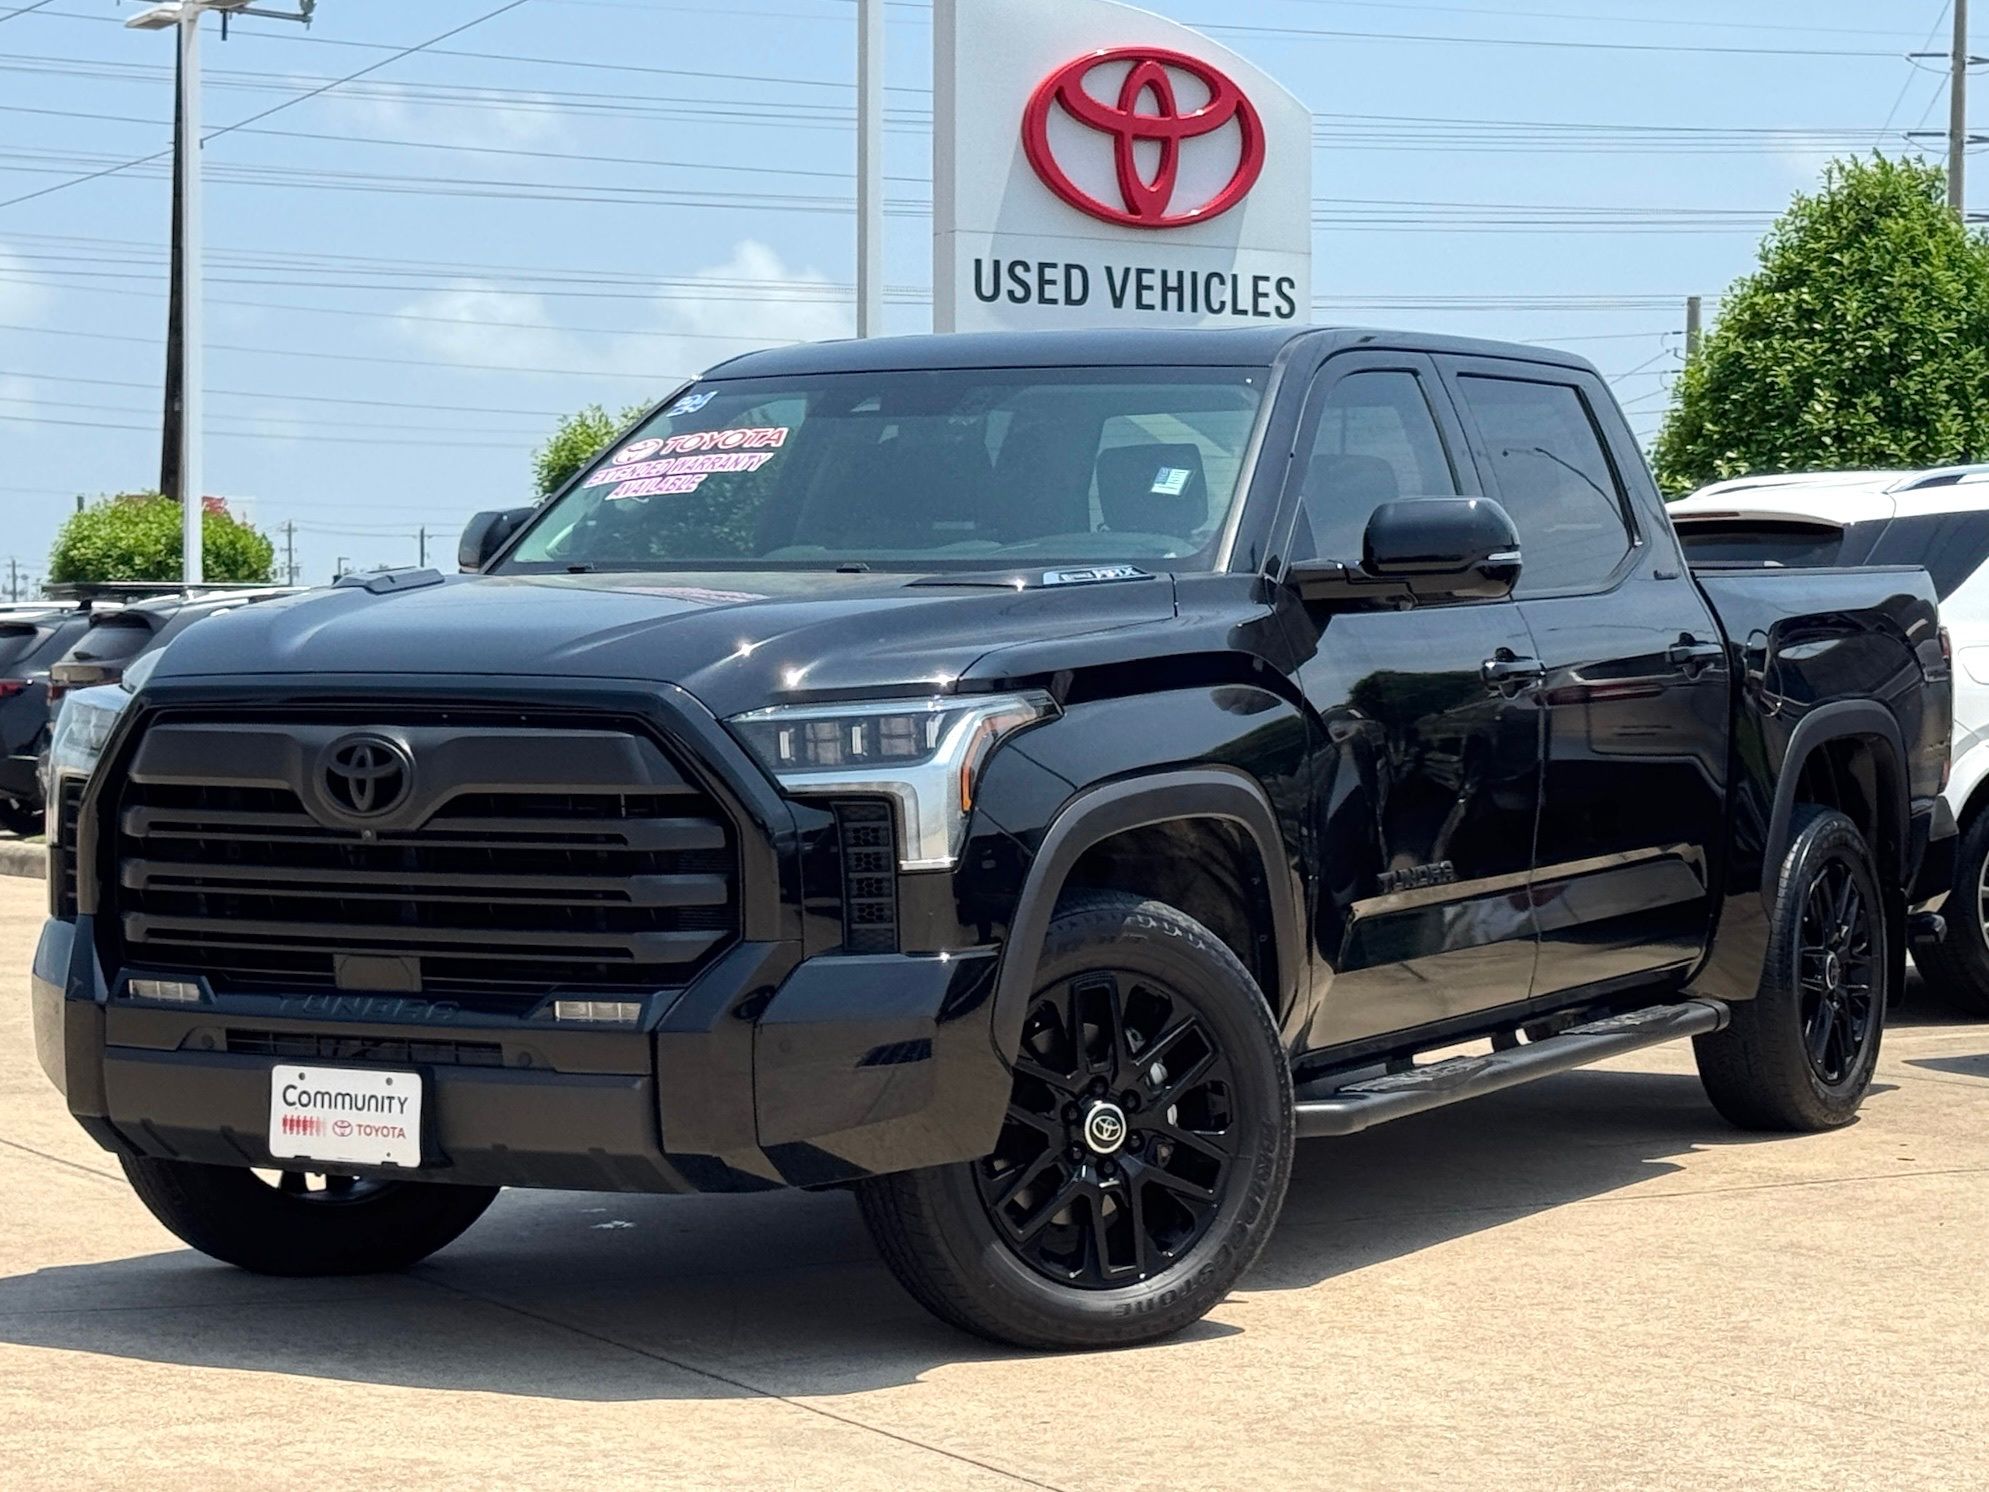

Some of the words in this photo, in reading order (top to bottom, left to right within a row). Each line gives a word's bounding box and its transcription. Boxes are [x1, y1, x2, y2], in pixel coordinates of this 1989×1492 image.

[974, 258, 1090, 307] USED
[1104, 265, 1297, 320] VEHICLES
[660, 427, 788, 455] TOYOTA
[587, 458, 674, 487] EXTENDED
[671, 452, 770, 474] WARRANTY
[608, 474, 706, 499] AVAILABLE
[280, 993, 461, 1020] TUNDRA
[356, 1124, 407, 1140] TOYOTA
